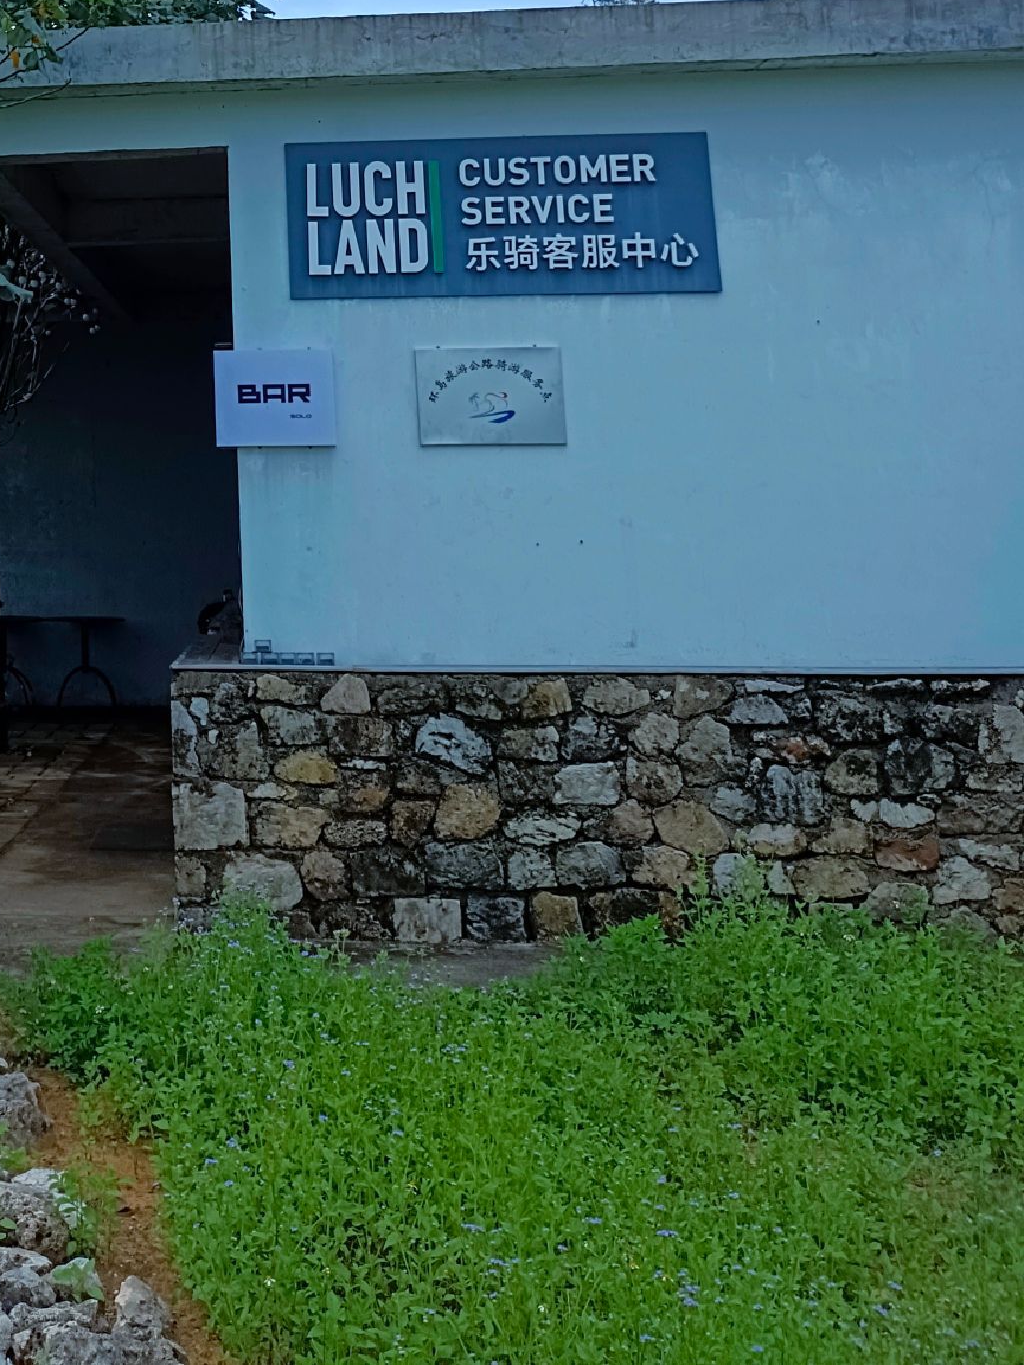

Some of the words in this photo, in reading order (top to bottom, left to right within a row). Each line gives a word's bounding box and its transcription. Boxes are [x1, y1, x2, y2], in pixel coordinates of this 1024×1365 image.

[459, 153, 657, 187] CUSTOMER
[306, 160, 426, 218] LUCH
[461, 193, 615, 226] SERVICE
[307, 218, 429, 276] LAND
[465, 231, 699, 271] 乐骑客服中心
[237, 383, 311, 404] BAR
